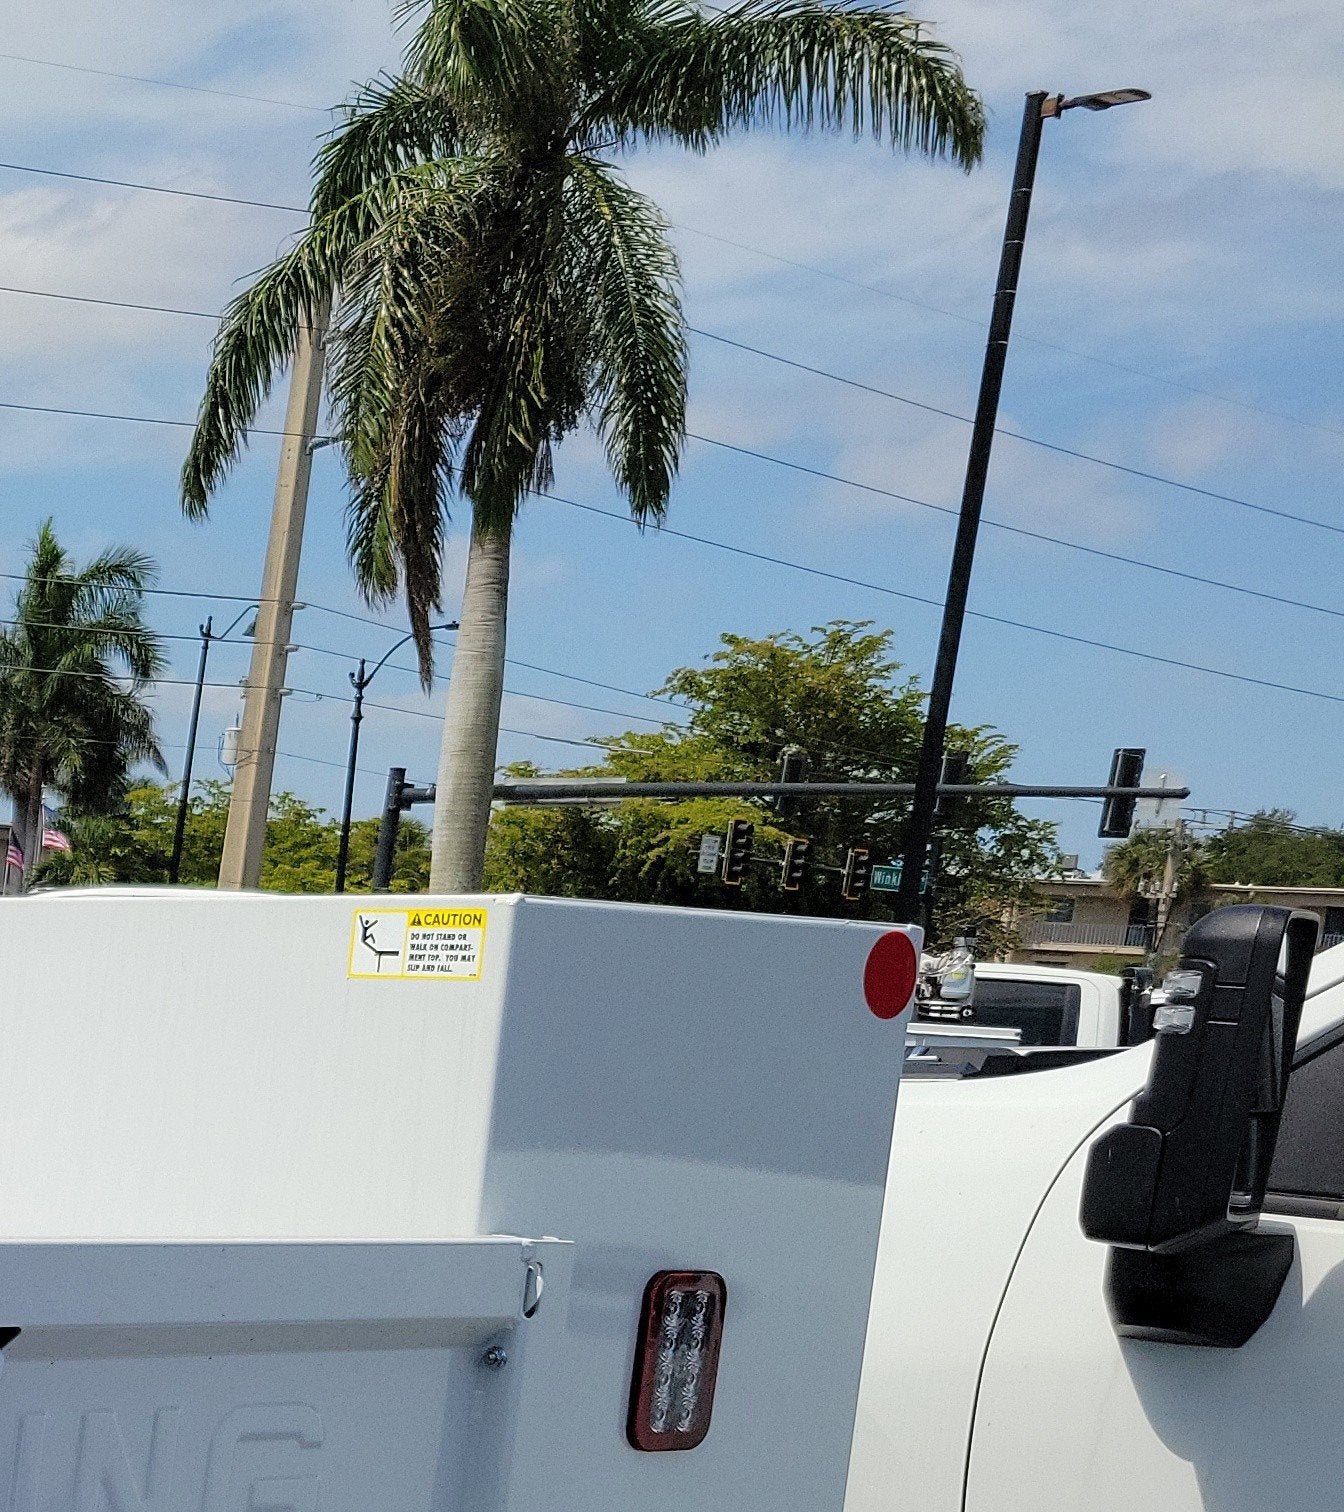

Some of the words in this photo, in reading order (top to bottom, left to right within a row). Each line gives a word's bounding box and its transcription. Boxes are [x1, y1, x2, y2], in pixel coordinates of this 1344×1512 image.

[424, 913, 482, 926] CAUTION
[411, 933, 421, 941] DO
[422, 933, 434, 941] NOT
[436, 933, 456, 941] STAND
[458, 933, 467, 941] OR
[410, 943, 427, 951] WALK
[429, 943, 439, 951] ON
[409, 954, 426, 962] MENT
[445, 953, 458, 962] YOU
[460, 953, 476, 962] MAY
[407, 964, 421, 972] SLIP
[422, 964, 435, 972] AND
